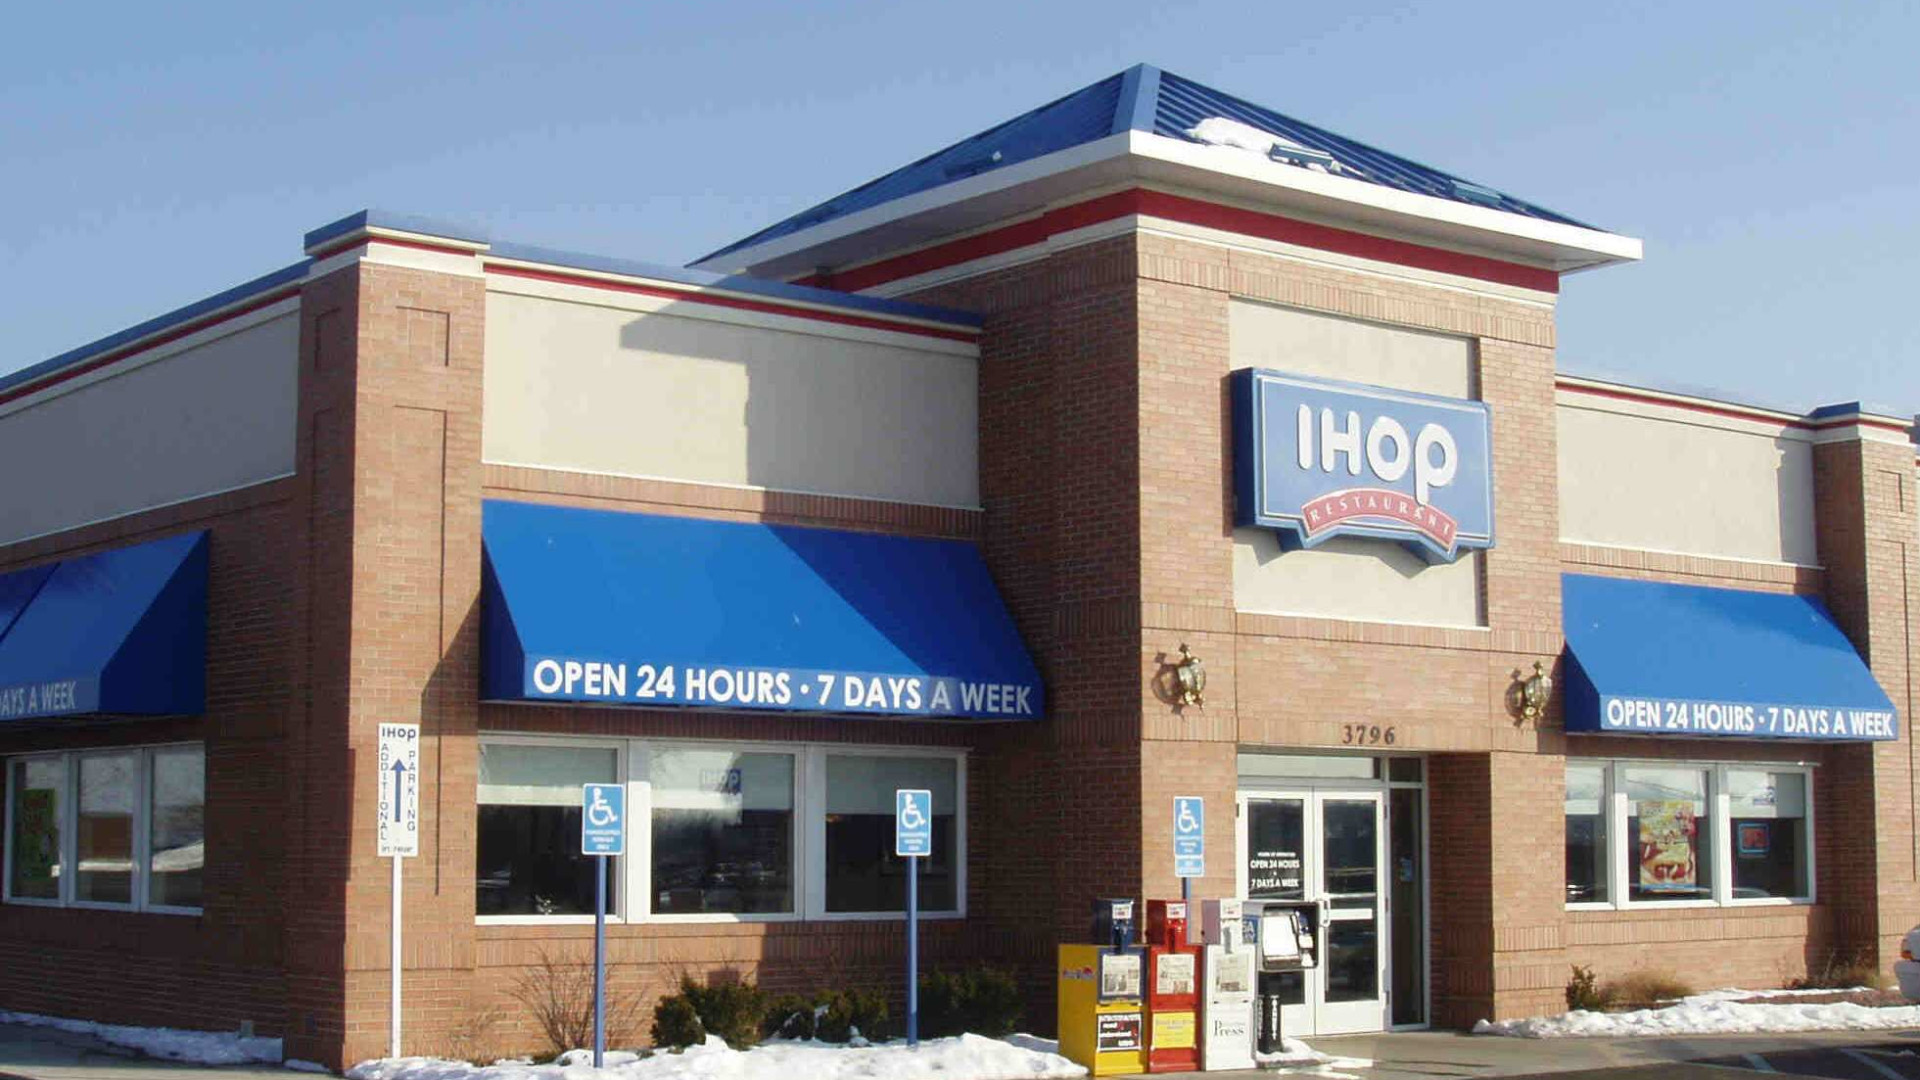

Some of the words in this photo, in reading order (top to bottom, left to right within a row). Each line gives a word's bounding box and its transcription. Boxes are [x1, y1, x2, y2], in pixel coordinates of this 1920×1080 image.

[1310, 495, 1450, 536] RESTAURANT
[0, 687, 25, 716] AYS
[27, 685, 39, 713] A
[41, 680, 77, 712] WEEK
[533, 659, 626, 696] OPEN
[636, 665, 675, 698] 24
[685, 668, 791, 705] HOURS
[817, 674, 835, 706] 7
[844, 676, 921, 709] DAYS
[930, 681, 952, 710] A
[960, 682, 1032, 714] WEEK
[1342, 724, 1395, 745] 3796
[1607, 699, 1660, 728] OPEN
[1666, 701, 1688, 729] 24
[1693, 704, 1754, 732] HOURS
[1768, 707, 1778, 732] 7
[1784, 708, 1828, 735] DAYS
[1833, 709, 1847, 735] A
[1850, 711, 1893, 736] WEEK
[380, 743, 389, 840] ADDITIONAL
[407, 750, 416, 832] PARKING
